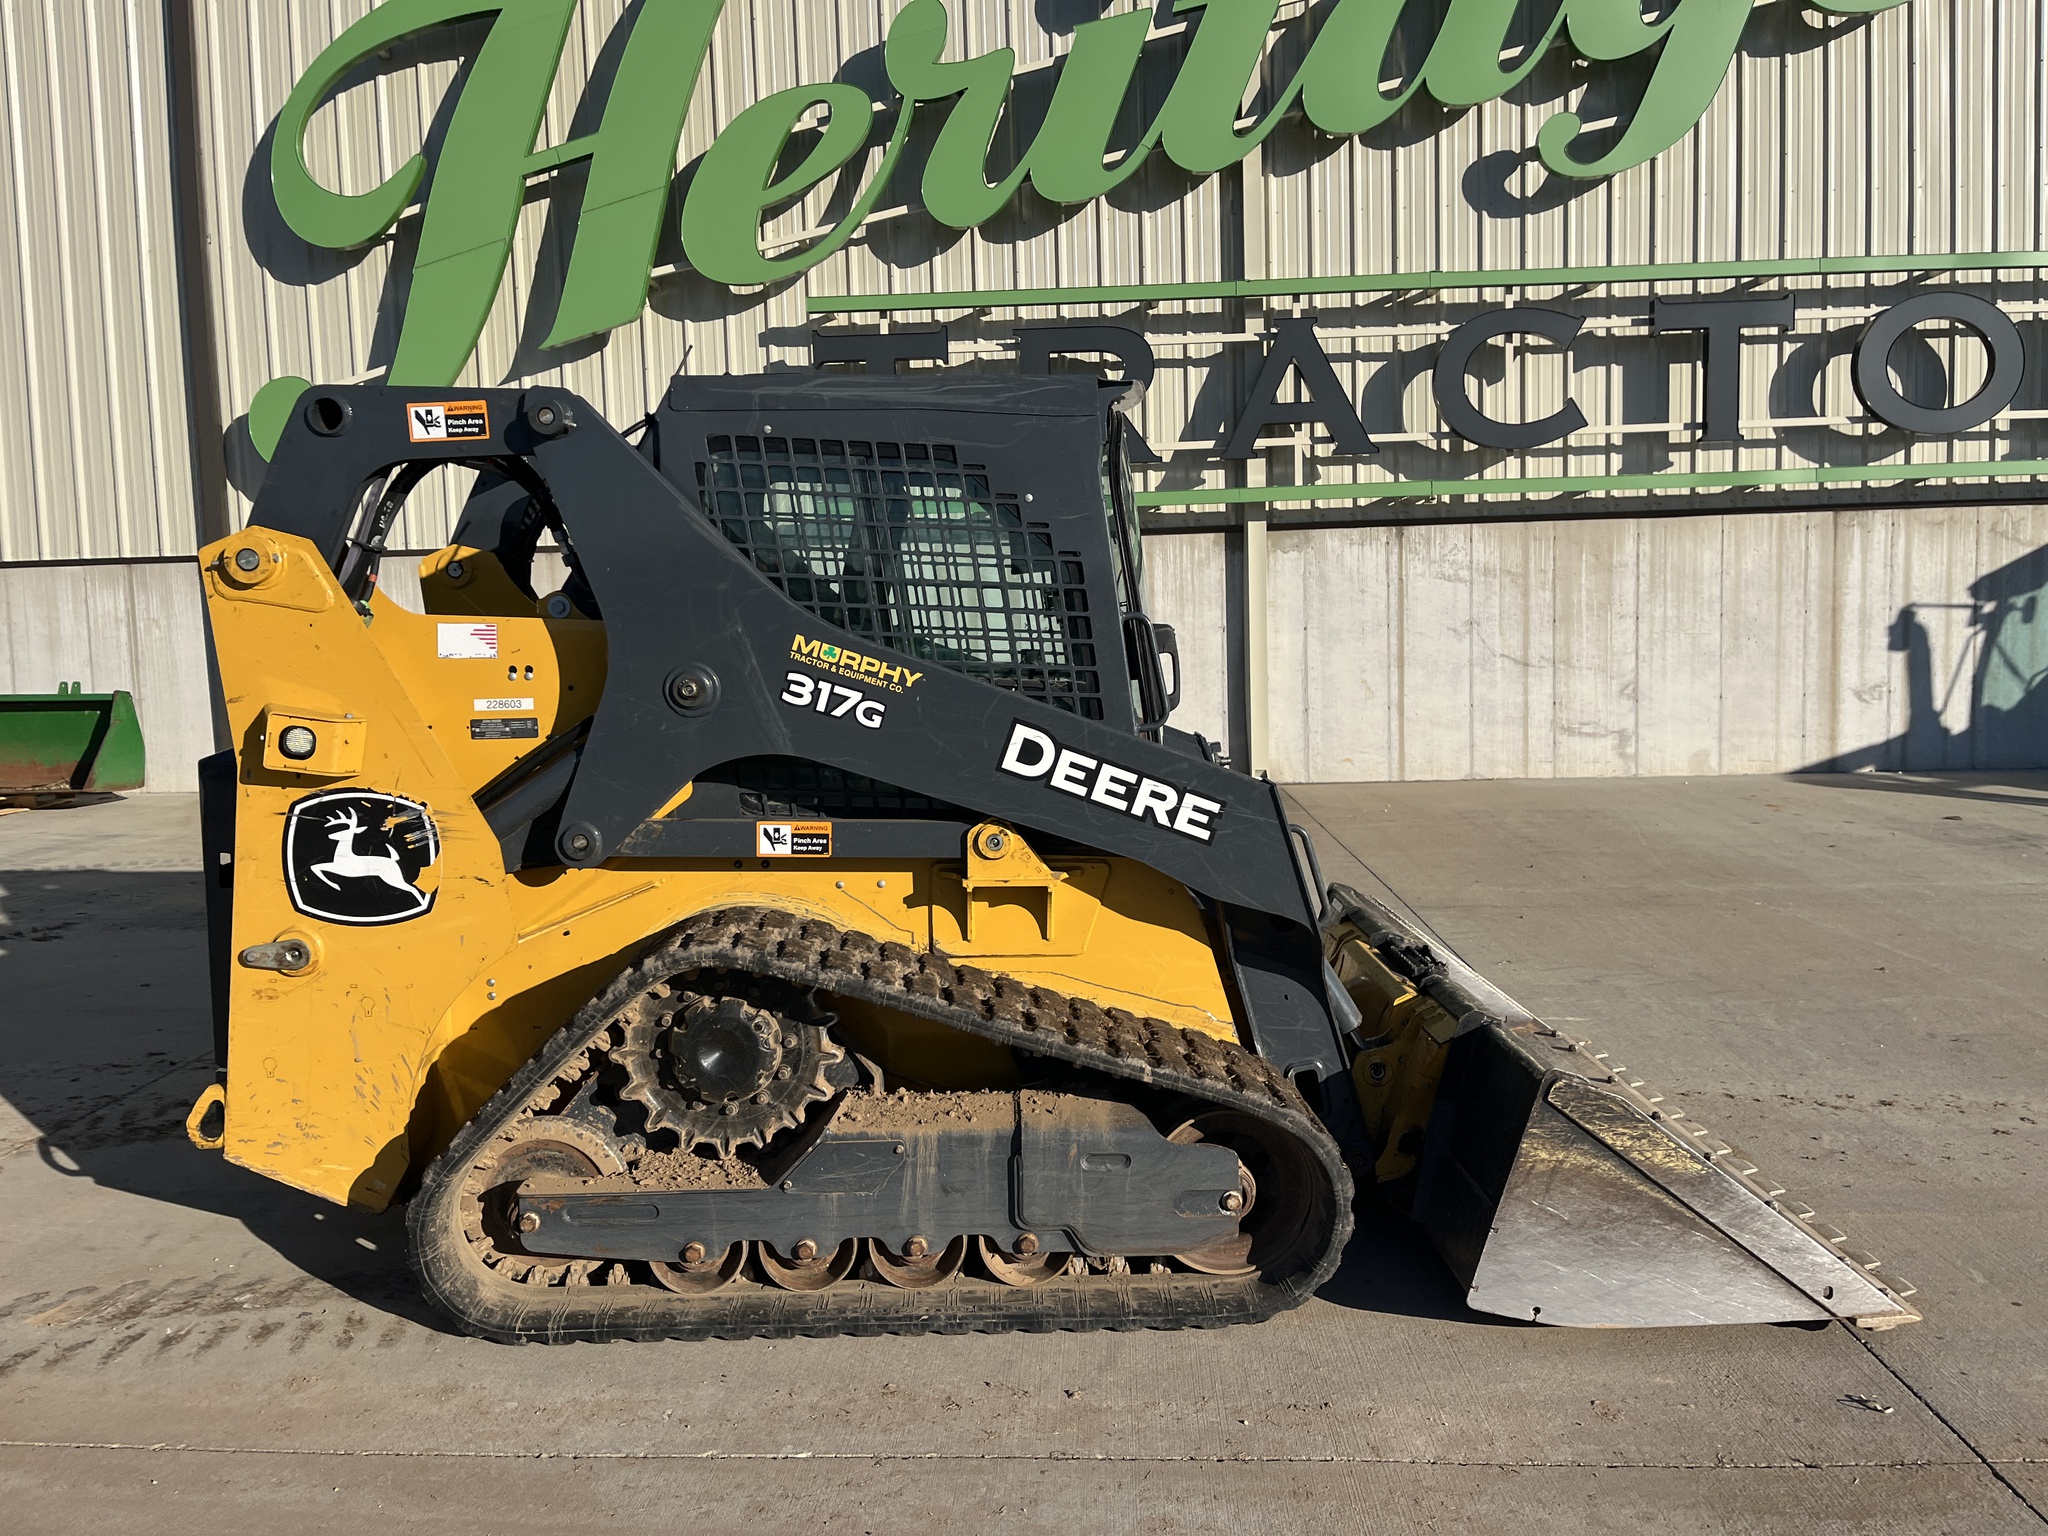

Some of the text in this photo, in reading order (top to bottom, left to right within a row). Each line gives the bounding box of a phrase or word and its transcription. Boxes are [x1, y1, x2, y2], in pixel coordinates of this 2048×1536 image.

[247, 0, 1910, 463] Heritag
[789, 651, 904, 694] TRACTOR & EQUIPMENT CO.
[791, 634, 924, 688] MURPHY
[486, 699, 522, 709] 228603
[780, 672, 887, 729] 317G
[1000, 722, 1222, 842] DEERE
